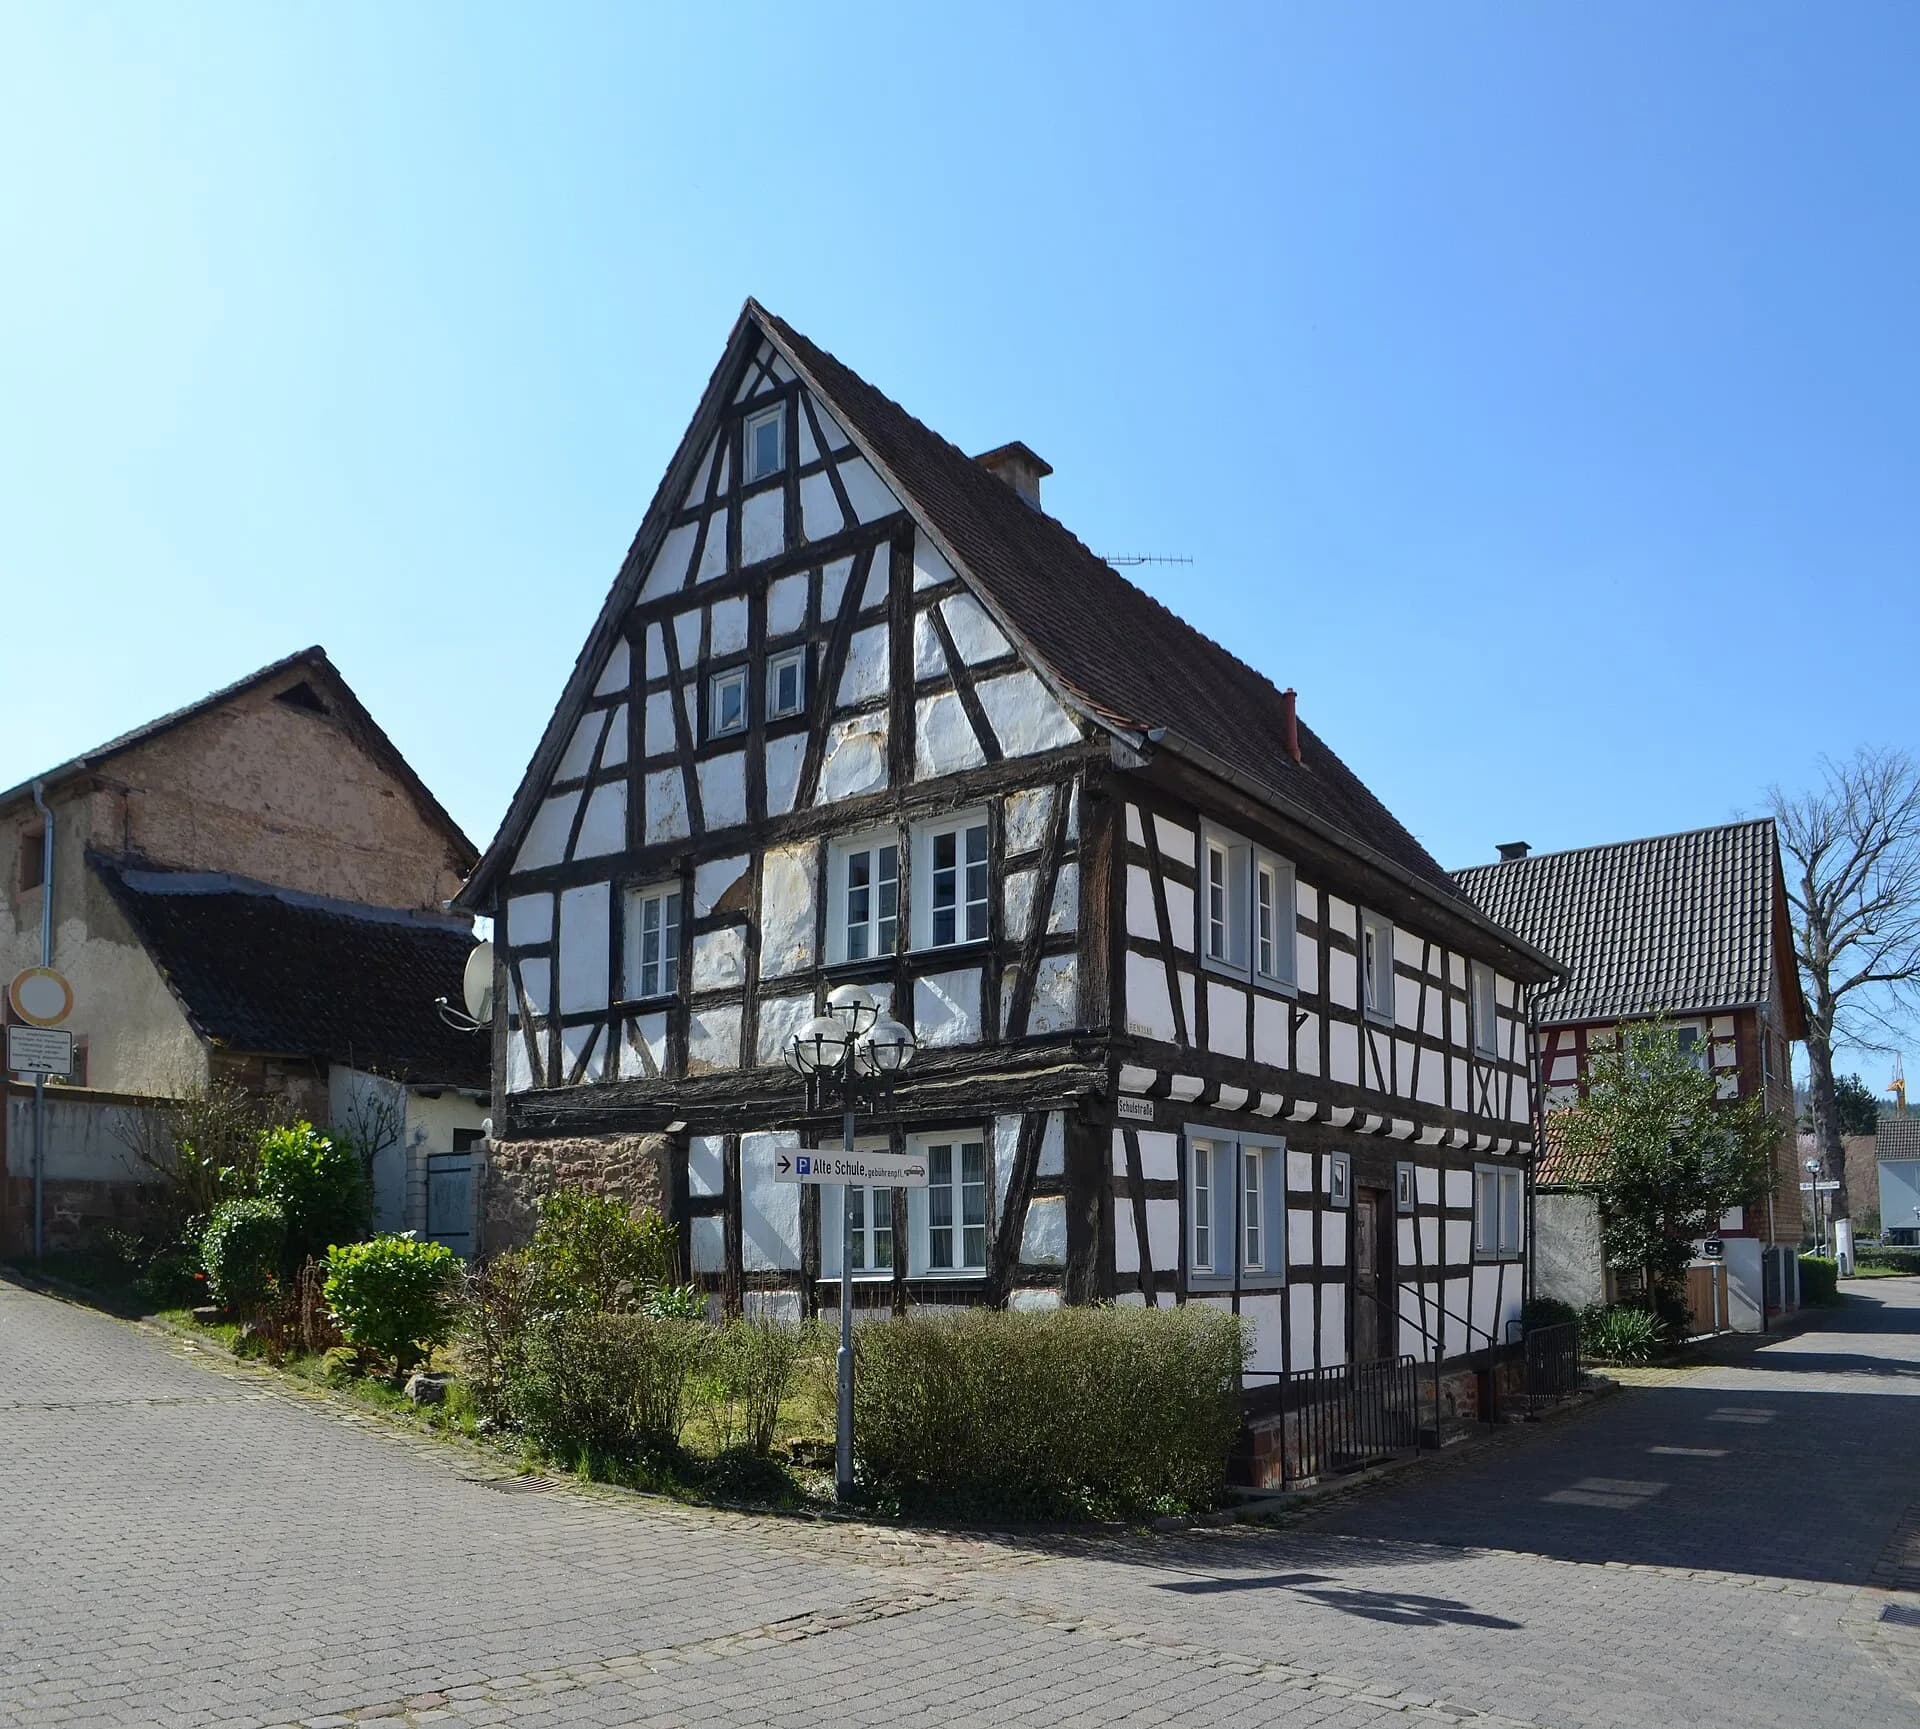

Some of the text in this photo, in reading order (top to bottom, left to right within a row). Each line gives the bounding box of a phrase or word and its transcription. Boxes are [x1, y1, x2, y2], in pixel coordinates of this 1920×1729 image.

[1119, 1099, 1152, 1115] Schulstraße
[799, 1158, 808, 1172] P
[813, 1159, 831, 1174] Alte
